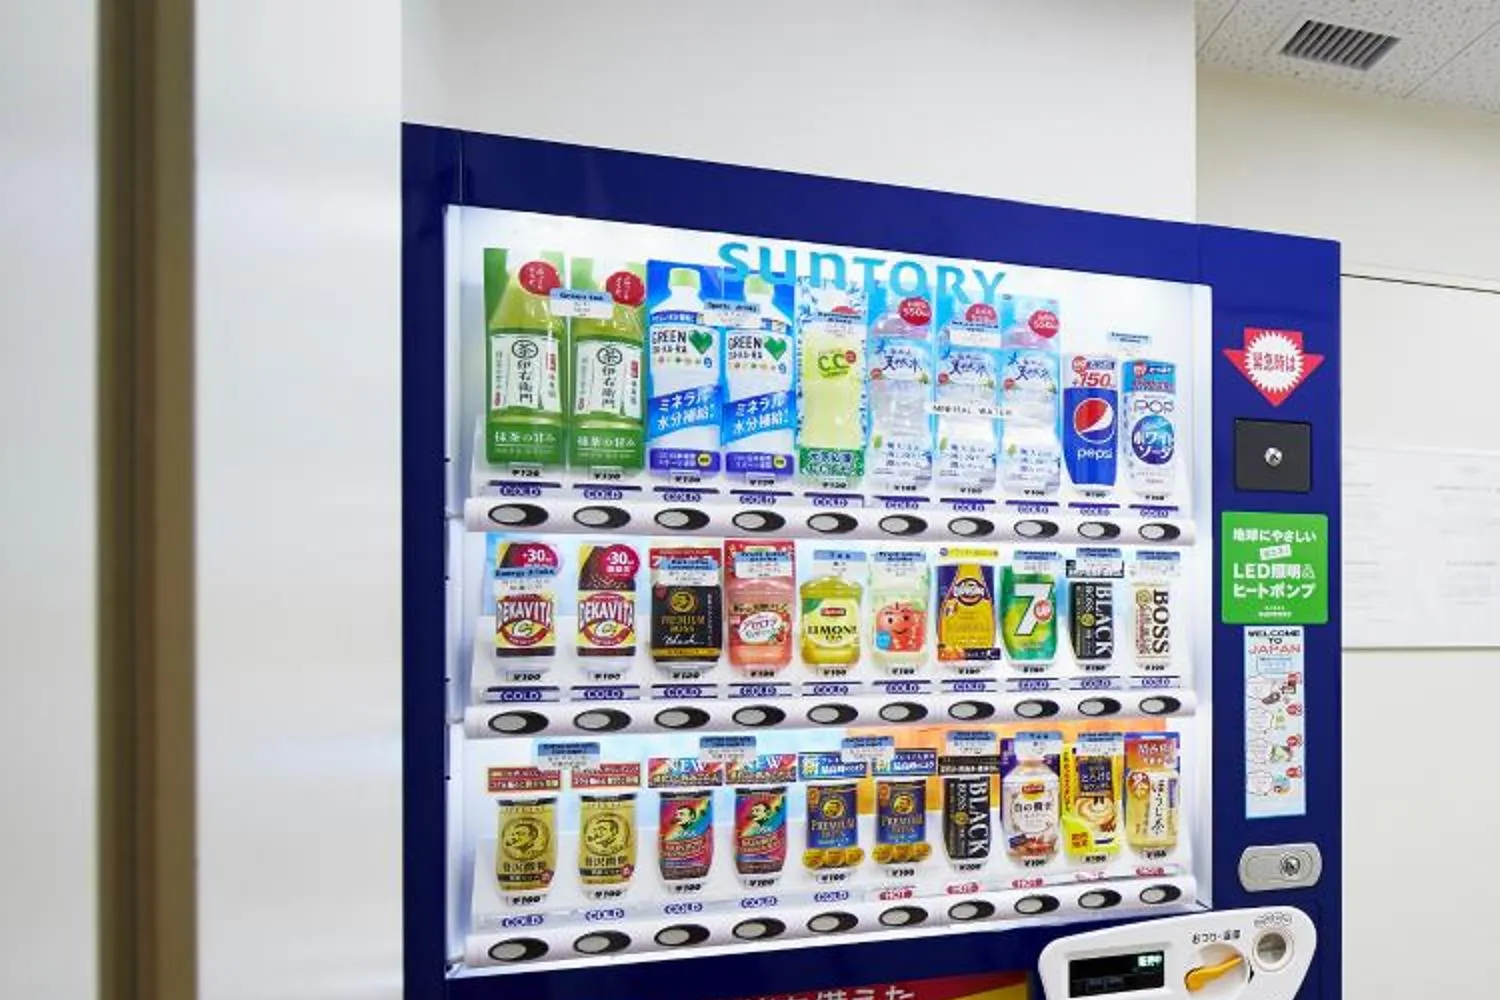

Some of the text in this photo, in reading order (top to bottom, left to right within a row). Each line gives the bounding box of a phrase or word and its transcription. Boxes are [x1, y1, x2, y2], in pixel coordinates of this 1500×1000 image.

[718, 242, 1006, 305] SUNTORY
[652, 330, 687, 344] GREEN
[728, 337, 762, 350] GREEN
[1077, 449, 1113, 460] pepsi
[1094, 585, 1113, 656] BLACK
[1152, 590, 1169, 655] BOSS
[1248, 629, 1301, 637] WELCOME
[1268, 637, 1283, 645] TO
[1249, 644, 1301, 654] JAPAN
[502, 692, 540, 700] COLD
[587, 690, 621, 699] COLD
[666, 688, 701, 697] COLD
[967, 781, 983, 855] BLACK
